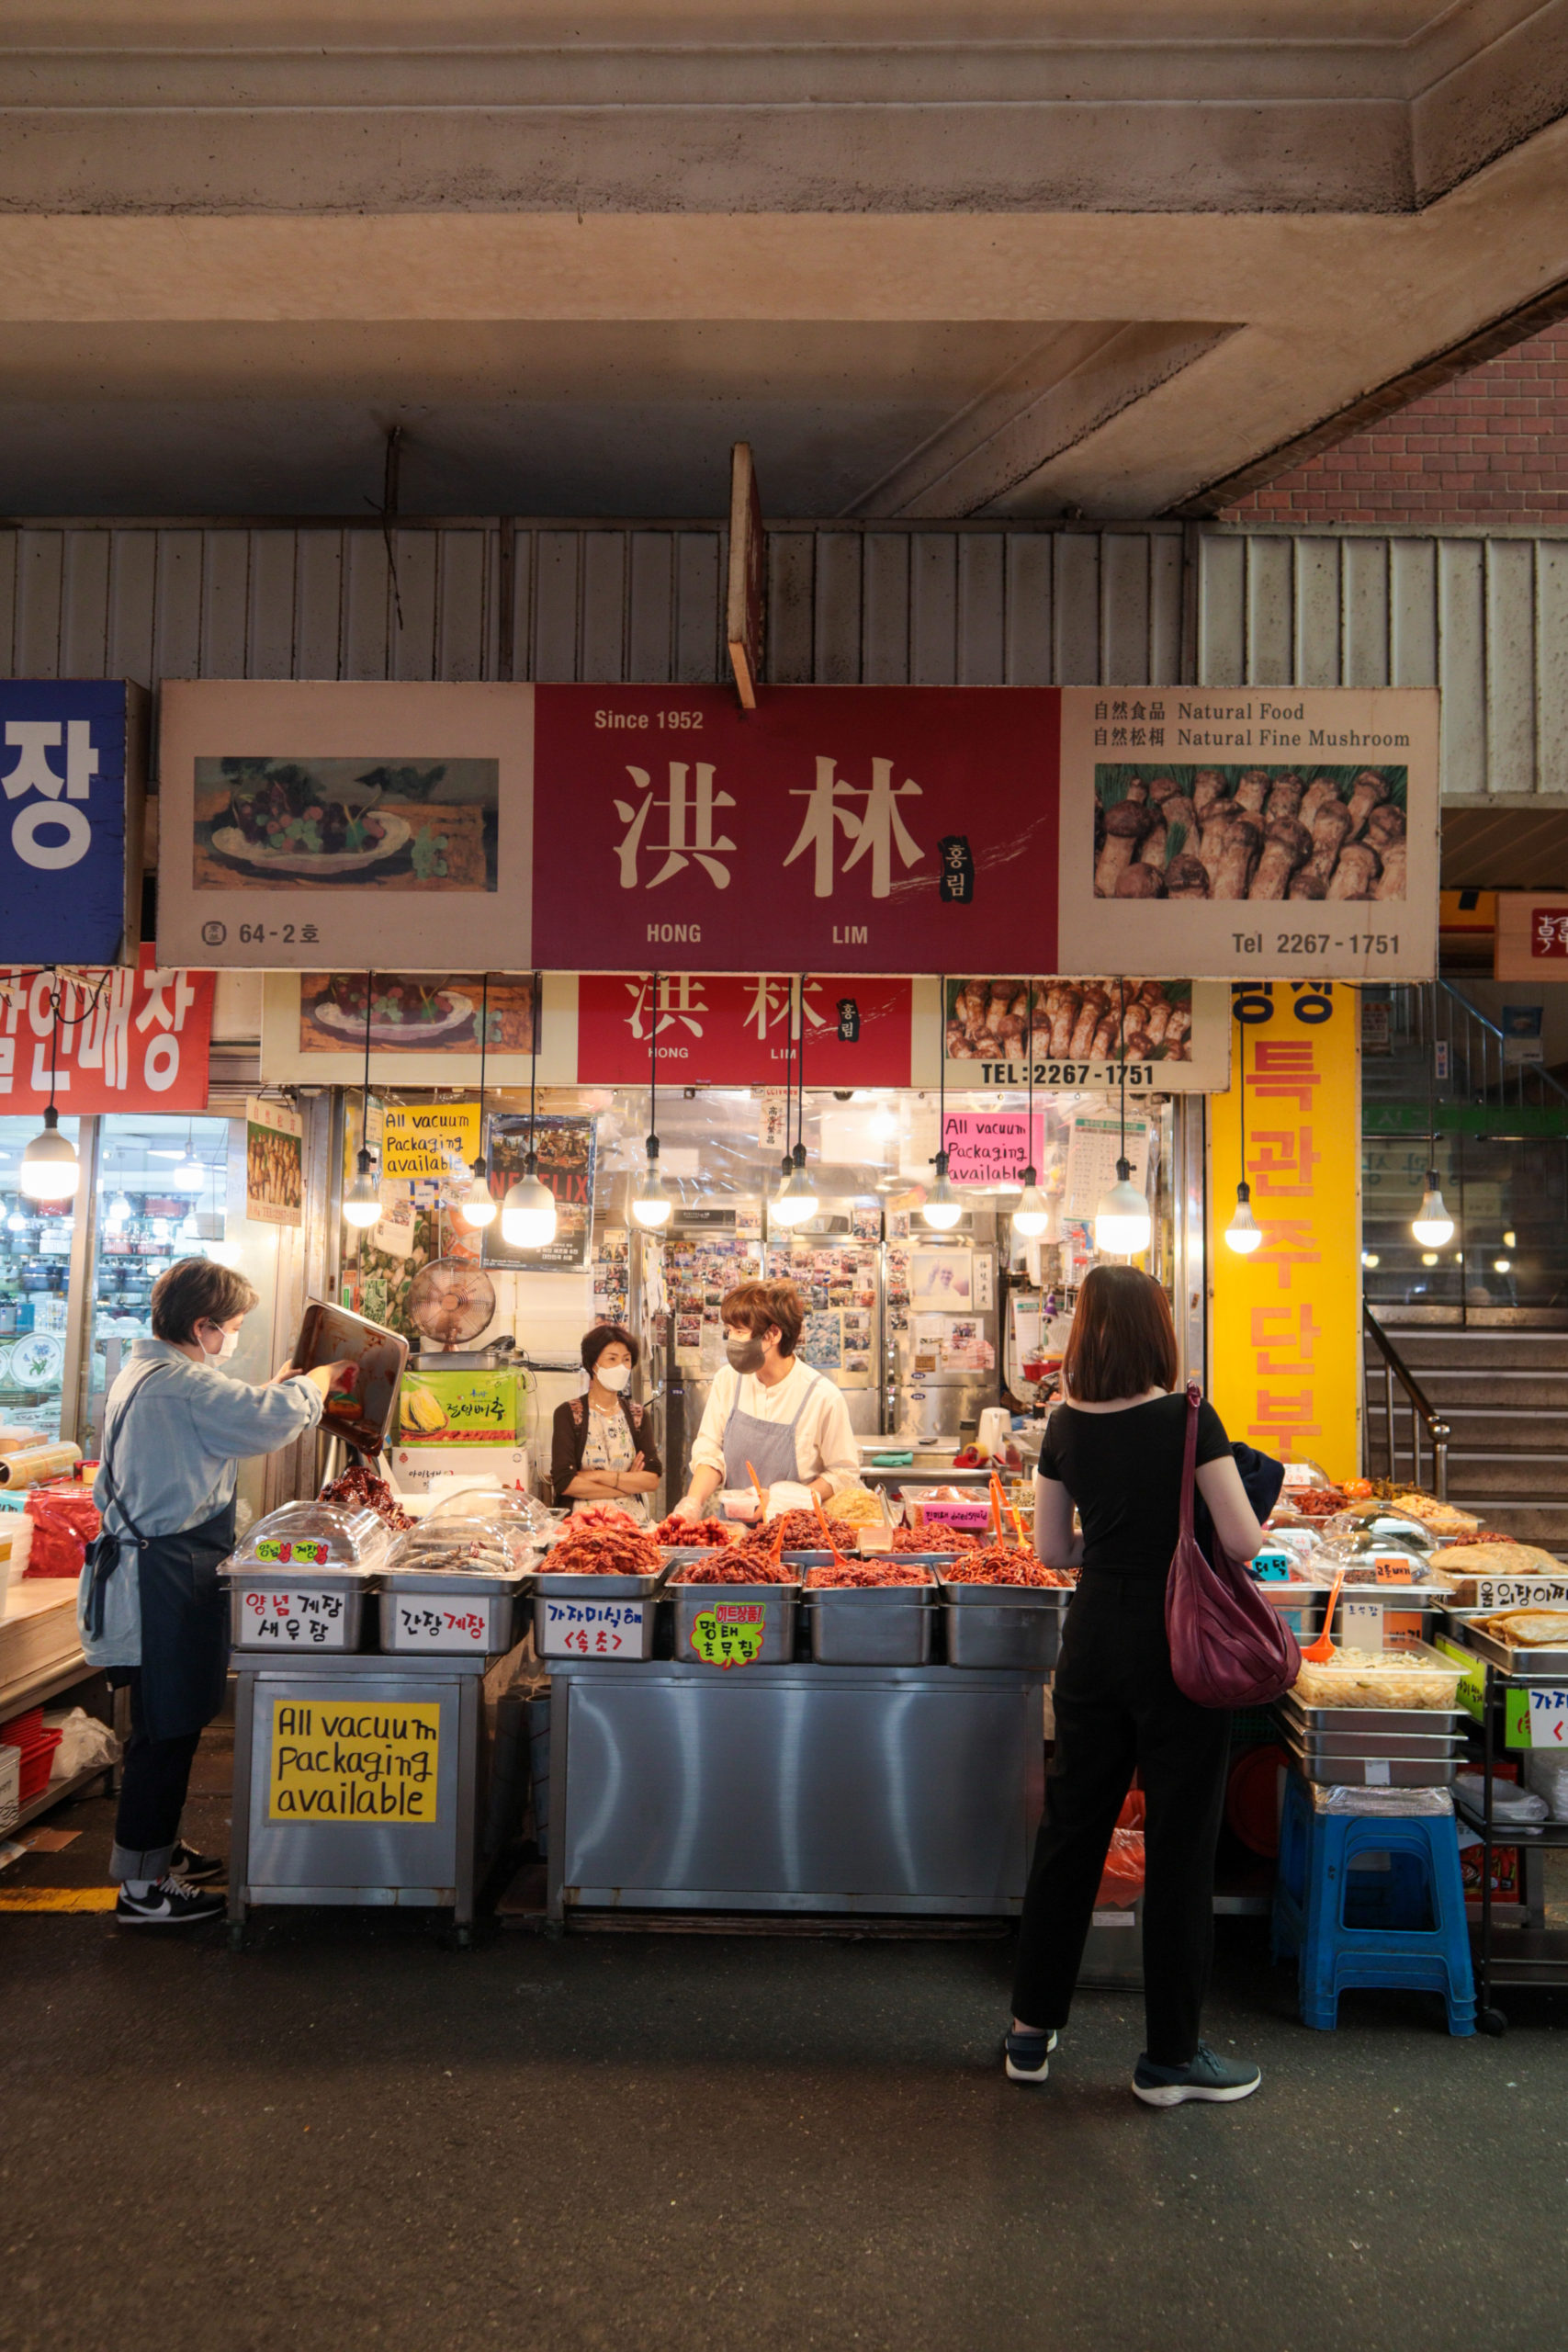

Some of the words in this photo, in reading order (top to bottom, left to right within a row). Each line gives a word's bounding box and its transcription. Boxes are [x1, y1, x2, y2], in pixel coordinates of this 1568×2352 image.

[594, 710, 649, 729] Since
[656, 710, 704, 729] 1952
[1094, 700, 1166, 720] 自然食品
[1178, 702, 1252, 719] Natural
[1259, 702, 1304, 720] Food
[1178, 729, 1252, 746] Natural
[1259, 729, 1302, 746] Fine
[1308, 729, 1411, 747] Mushroom
[1, 720, 99, 870] 장
[944, 843, 967, 898] 홍림
[647, 923, 702, 944] HONG
[832, 925, 868, 945] LIM
[1232, 933, 1263, 954] Tel
[1276, 934, 1400, 955] 2267-1751
[648, 1047, 689, 1058] HONG
[771, 1048, 796, 1059] LIM
[386, 1113, 405, 1128] All
[412, 1114, 469, 1128] vacuum
[945, 1118, 967, 1135] All
[976, 1123, 1026, 1136] vacuum
[387, 1134, 463, 1154] Packaging
[948, 1142, 1027, 1162] Packaging
[387, 1154, 462, 1173] available
[490, 1171, 589, 1204] NEFLIX
[246, 1593, 289, 1617] 양념
[297, 1594, 343, 1618] 게장
[279, 1707, 311, 1736] All
[321, 1716, 436, 1741] vacuum
[277, 1781, 423, 1815] available
